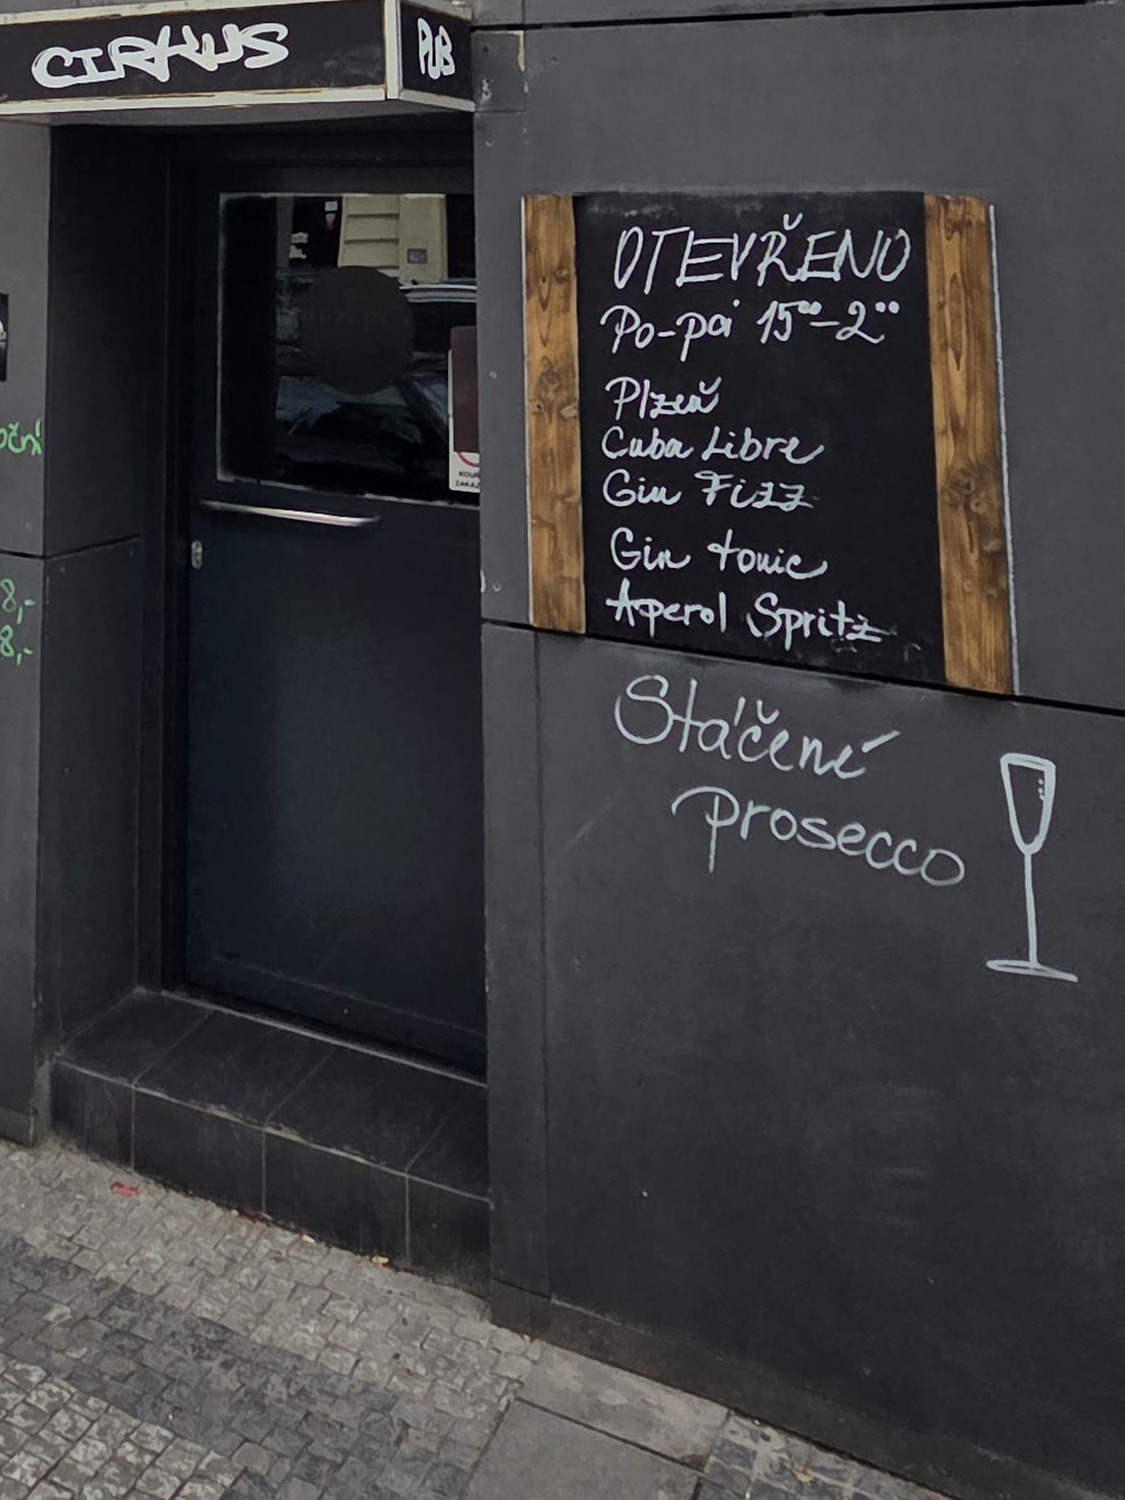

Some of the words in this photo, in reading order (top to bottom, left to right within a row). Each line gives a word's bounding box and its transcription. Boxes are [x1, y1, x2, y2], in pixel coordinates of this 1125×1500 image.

[30, 22, 290, 89] CIRKUS
[417, 17, 456, 80] PUB
[612, 212, 912, 295] OTEVŘENO
[605, 375, 722, 420] Plzeň
[601, 425, 695, 461] Cuba
[701, 425, 826, 465] Libre
[603, 468, 683, 507] Gin
[694, 469, 816, 512] Fizz
[610, 527, 691, 571] Gin
[605, 579, 728, 636] Aperol
[746, 591, 887, 651] Spritz
[614, 674, 901, 781] Stáčené
